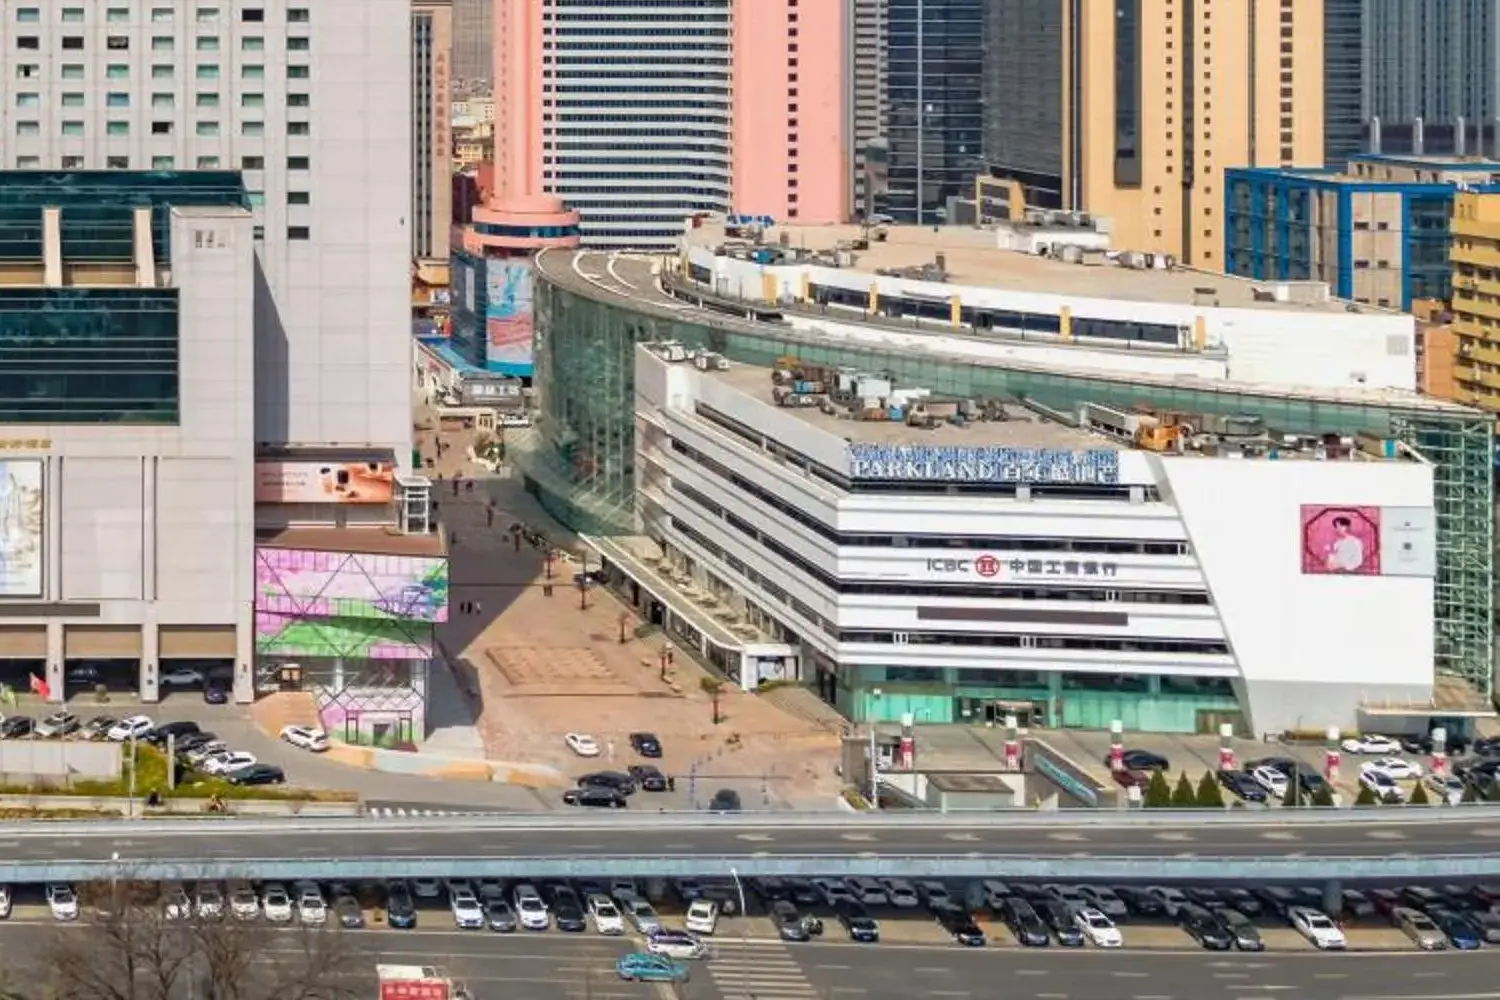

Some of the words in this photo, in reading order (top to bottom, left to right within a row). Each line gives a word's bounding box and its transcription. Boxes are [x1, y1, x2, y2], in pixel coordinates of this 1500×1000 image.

[854, 460, 994, 480] PARKLAND
[926, 557, 969, 573] ICBC
[1009, 558, 1119, 577] 中国工商银行
